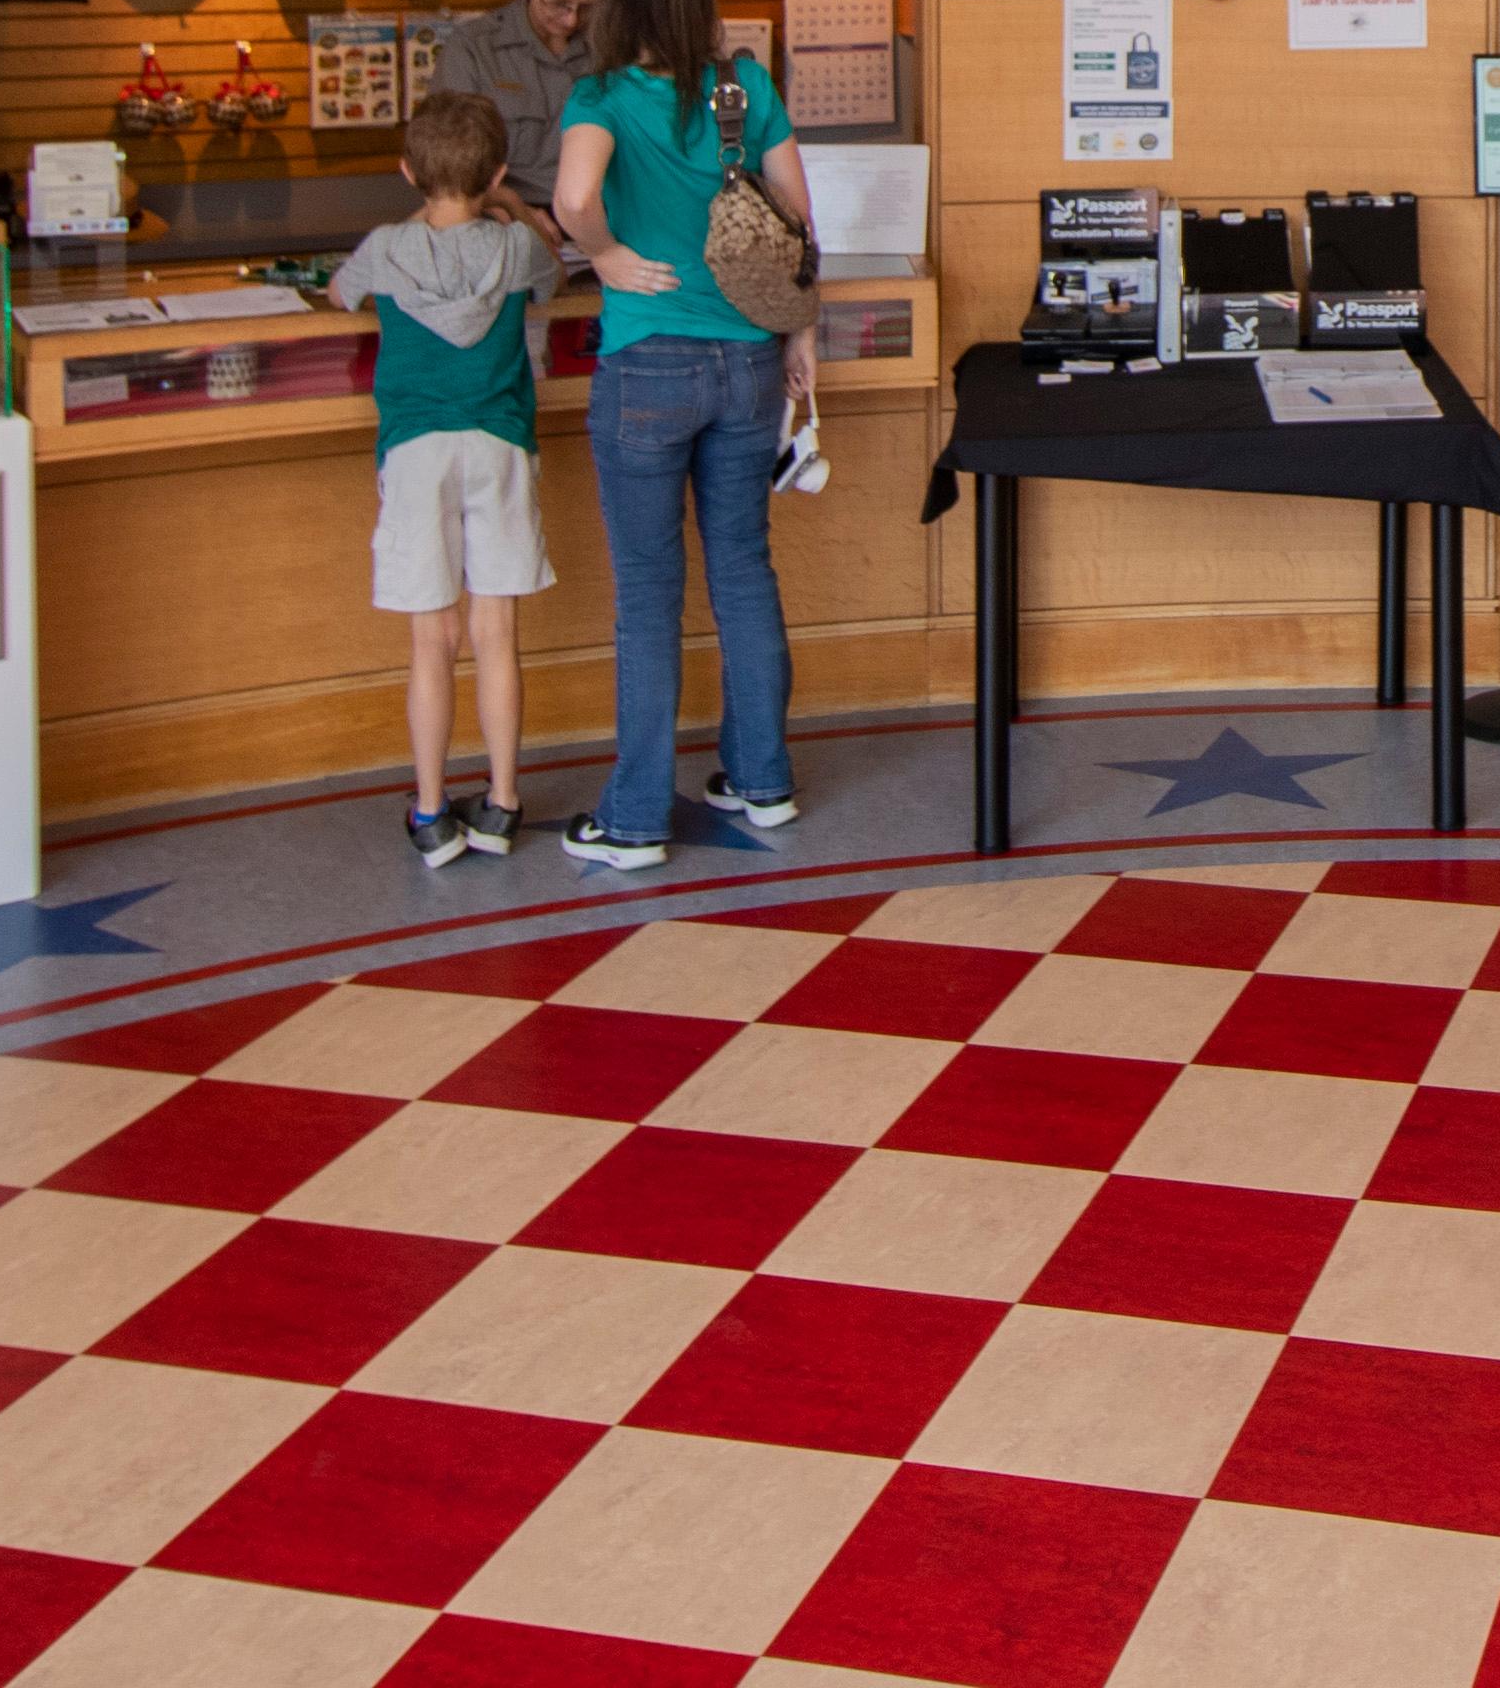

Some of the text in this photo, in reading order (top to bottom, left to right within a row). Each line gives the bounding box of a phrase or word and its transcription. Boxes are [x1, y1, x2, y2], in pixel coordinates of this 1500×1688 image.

[1077, 198, 1148, 215] Passport
[1050, 228, 1148, 239] Cancellation Station
[1346, 300, 1419, 318] Passport
